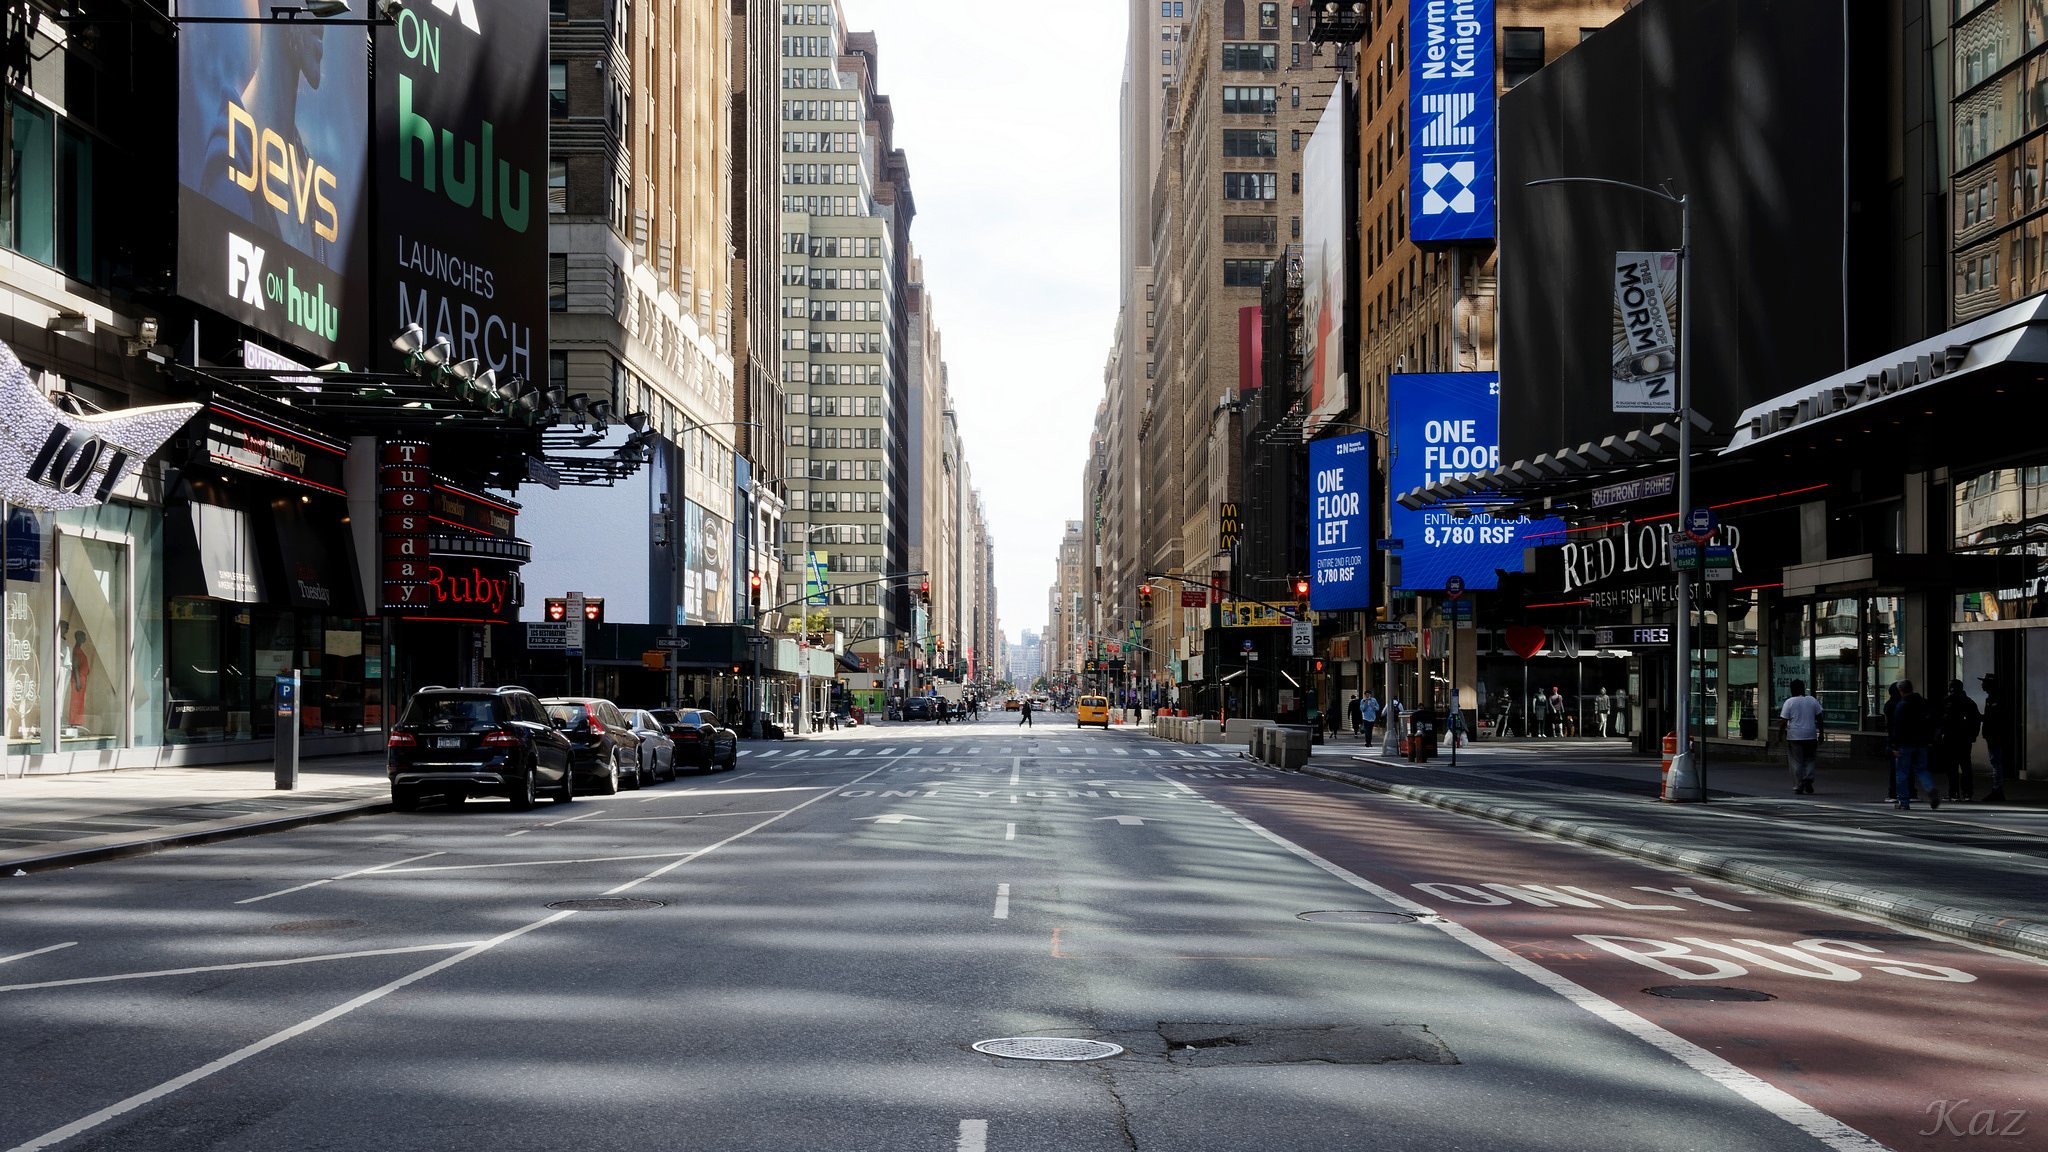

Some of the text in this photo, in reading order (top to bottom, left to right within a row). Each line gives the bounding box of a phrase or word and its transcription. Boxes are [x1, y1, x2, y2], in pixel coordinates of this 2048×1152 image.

[399, 8, 440, 74] ON
[1450, 0, 1480, 78] Knigh
[399, 73, 530, 233] hulu
[228, 100, 338, 243] DEVS
[399, 234, 495, 300] LAUNCHES
[228, 232, 338, 342] FX ON hulu
[399, 280, 531, 381] MARCH
[1797, 382, 1866, 423] TIMES
[1866, 344, 1972, 400] SQUARE
[1425, 420, 1476, 443] ONE
[267, 436, 306, 474] Tuesday
[1317, 468, 1344, 494] ONE
[1592, 477, 1672, 505] OUTFRONT PRIME
[1317, 492, 1359, 520] FLOOR
[1425, 513, 1465, 525] ENTIRE
[1467, 514, 1491, 525] 2ND
[400, 445, 416, 602] Tuesday
[1317, 520, 1348, 546] LEFT
[1425, 527, 1475, 548] 8,780
[1480, 526, 1515, 544] RSF
[1317, 555, 1361, 568] ENTIRE 2ND FLOOR
[1561, 535, 1615, 594] RED
[1678, 547, 1697, 556] M104
[428, 566, 507, 613] Ruby
[1317, 567, 1355, 586] 8,780 RSF
[297, 579, 330, 607] Tuesday
[1590, 591, 1618, 608] FRESH
[1621, 587, 1641, 605] FISH
[1647, 585, 1666, 603] LIVE
[1295, 635, 1311, 645] 25
[1633, 628, 1669, 643] FRES
[283, 685, 291, 697] P
[1410, 881, 1752, 912] ONLY
[1572, 934, 1979, 984] BUS
